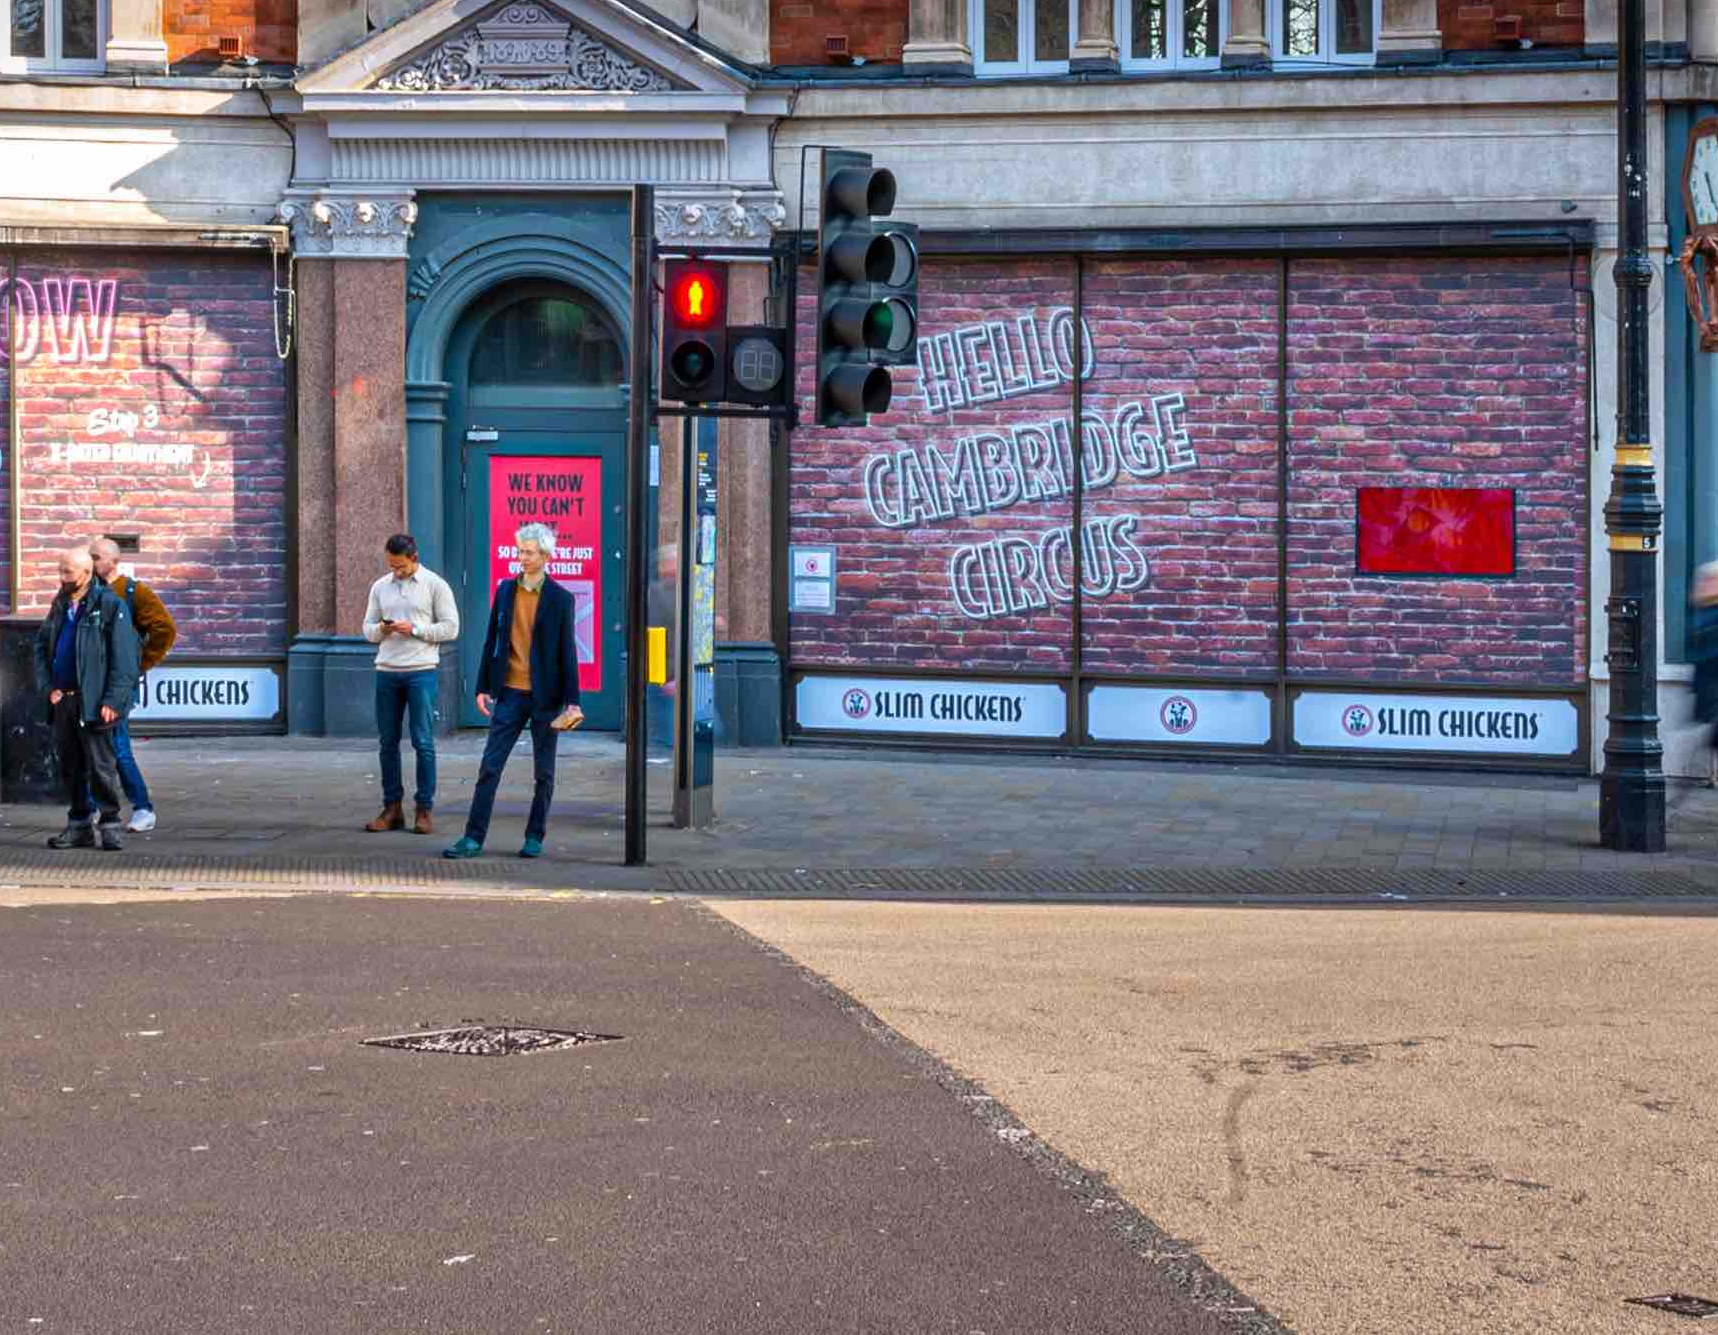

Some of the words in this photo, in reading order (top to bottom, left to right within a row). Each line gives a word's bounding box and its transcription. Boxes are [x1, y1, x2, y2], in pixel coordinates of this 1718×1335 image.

[917, 306, 1097, 413] HELLO
[87, 408, 140, 437] Step
[143, 404, 159, 428] 3
[863, 392, 1198, 528] CAMBRIDGE
[508, 473, 531, 491] WE
[536, 474, 583, 492] KNOW
[508, 497, 537, 515] YOU
[542, 497, 584, 516] CAN'T
[552, 547, 571, 559] E'RE
[573, 547, 593, 560] JUST
[1643, 537, 1651, 548] 5
[951, 515, 1149, 619] CIRCUS
[156, 679, 250, 705] CHICKENS
[875, 691, 924, 719] SLIM
[930, 694, 1023, 722] CHICKENS
[1378, 708, 1431, 736] SLIM
[1438, 710, 1539, 739] CHICKENS
